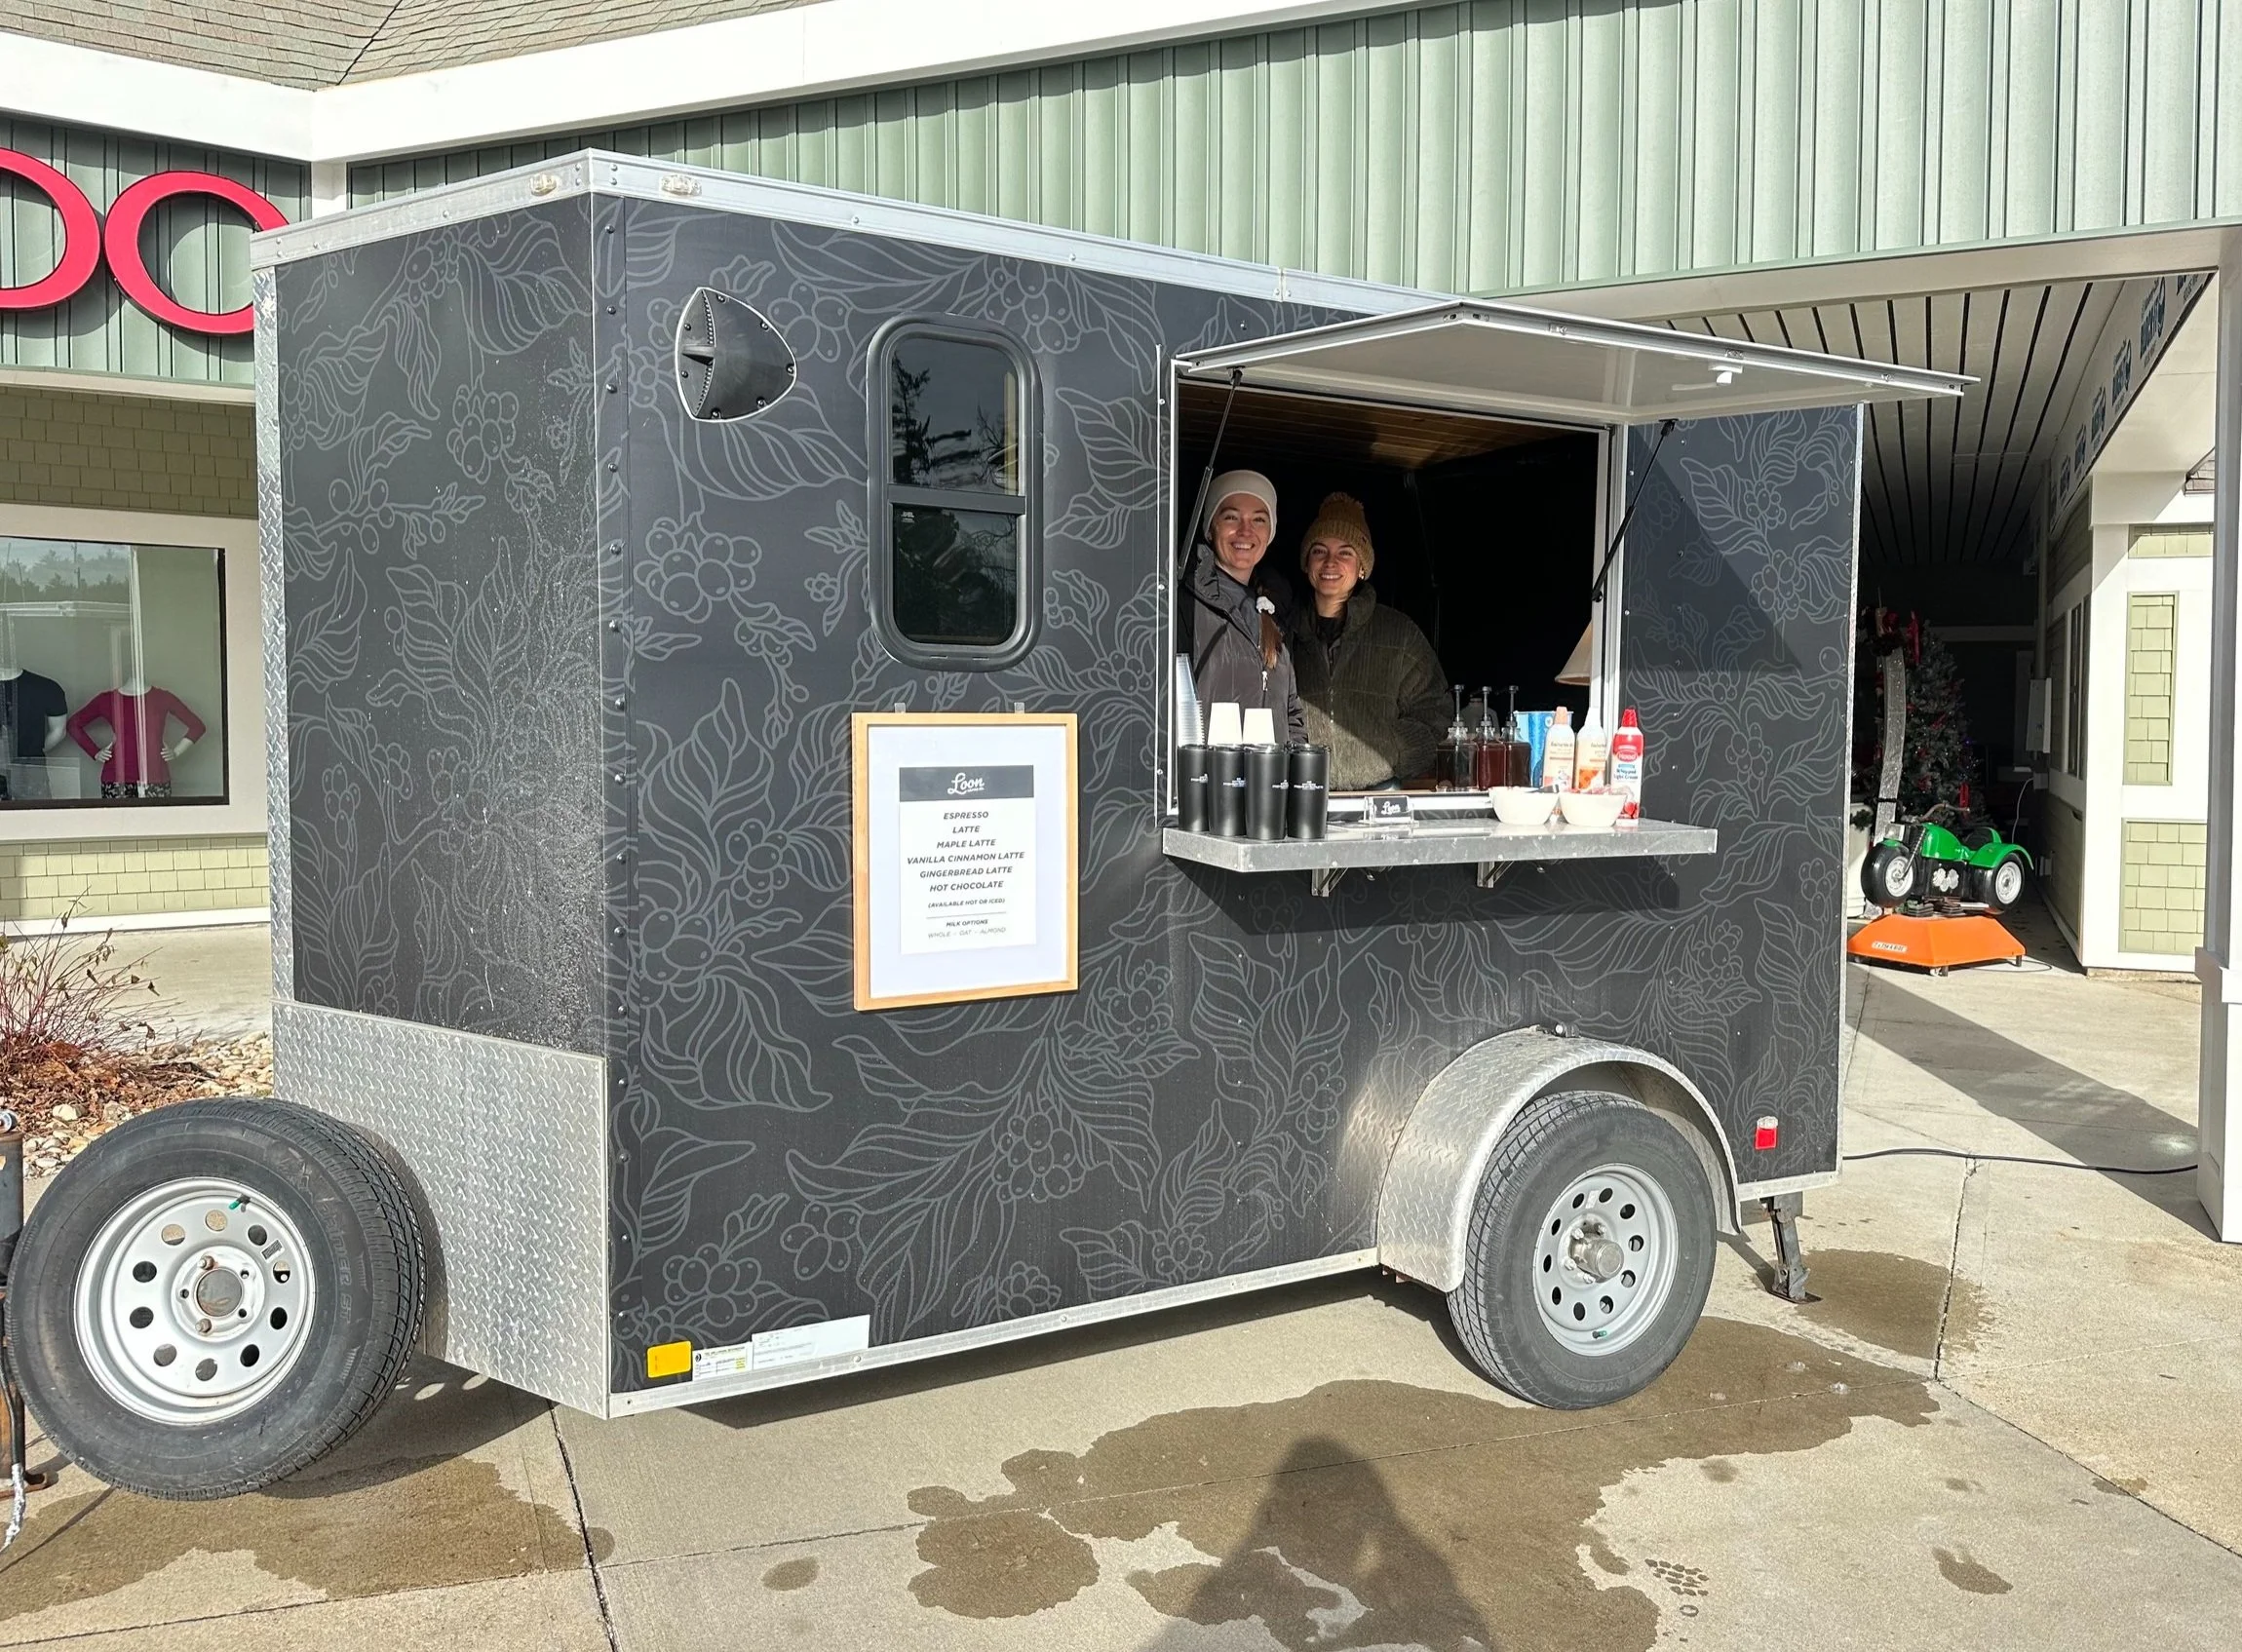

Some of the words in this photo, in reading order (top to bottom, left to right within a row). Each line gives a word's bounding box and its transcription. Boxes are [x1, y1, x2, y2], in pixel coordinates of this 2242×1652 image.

[947, 772, 986, 795] Loon
[944, 811, 989, 820] ESPRESSO
[936, 840, 967, 849] MAPLE
[907, 856, 946, 864] VANILLA
[947, 853, 996, 863] CINNAMON
[919, 867, 984, 878] GINGERBREAD
[929, 884, 948, 893] HOT
[950, 881, 1005, 891] CHOCOLATE
[927, 900, 964, 908] (AVAILABLE
[927, 931, 951, 940] WHOLE
